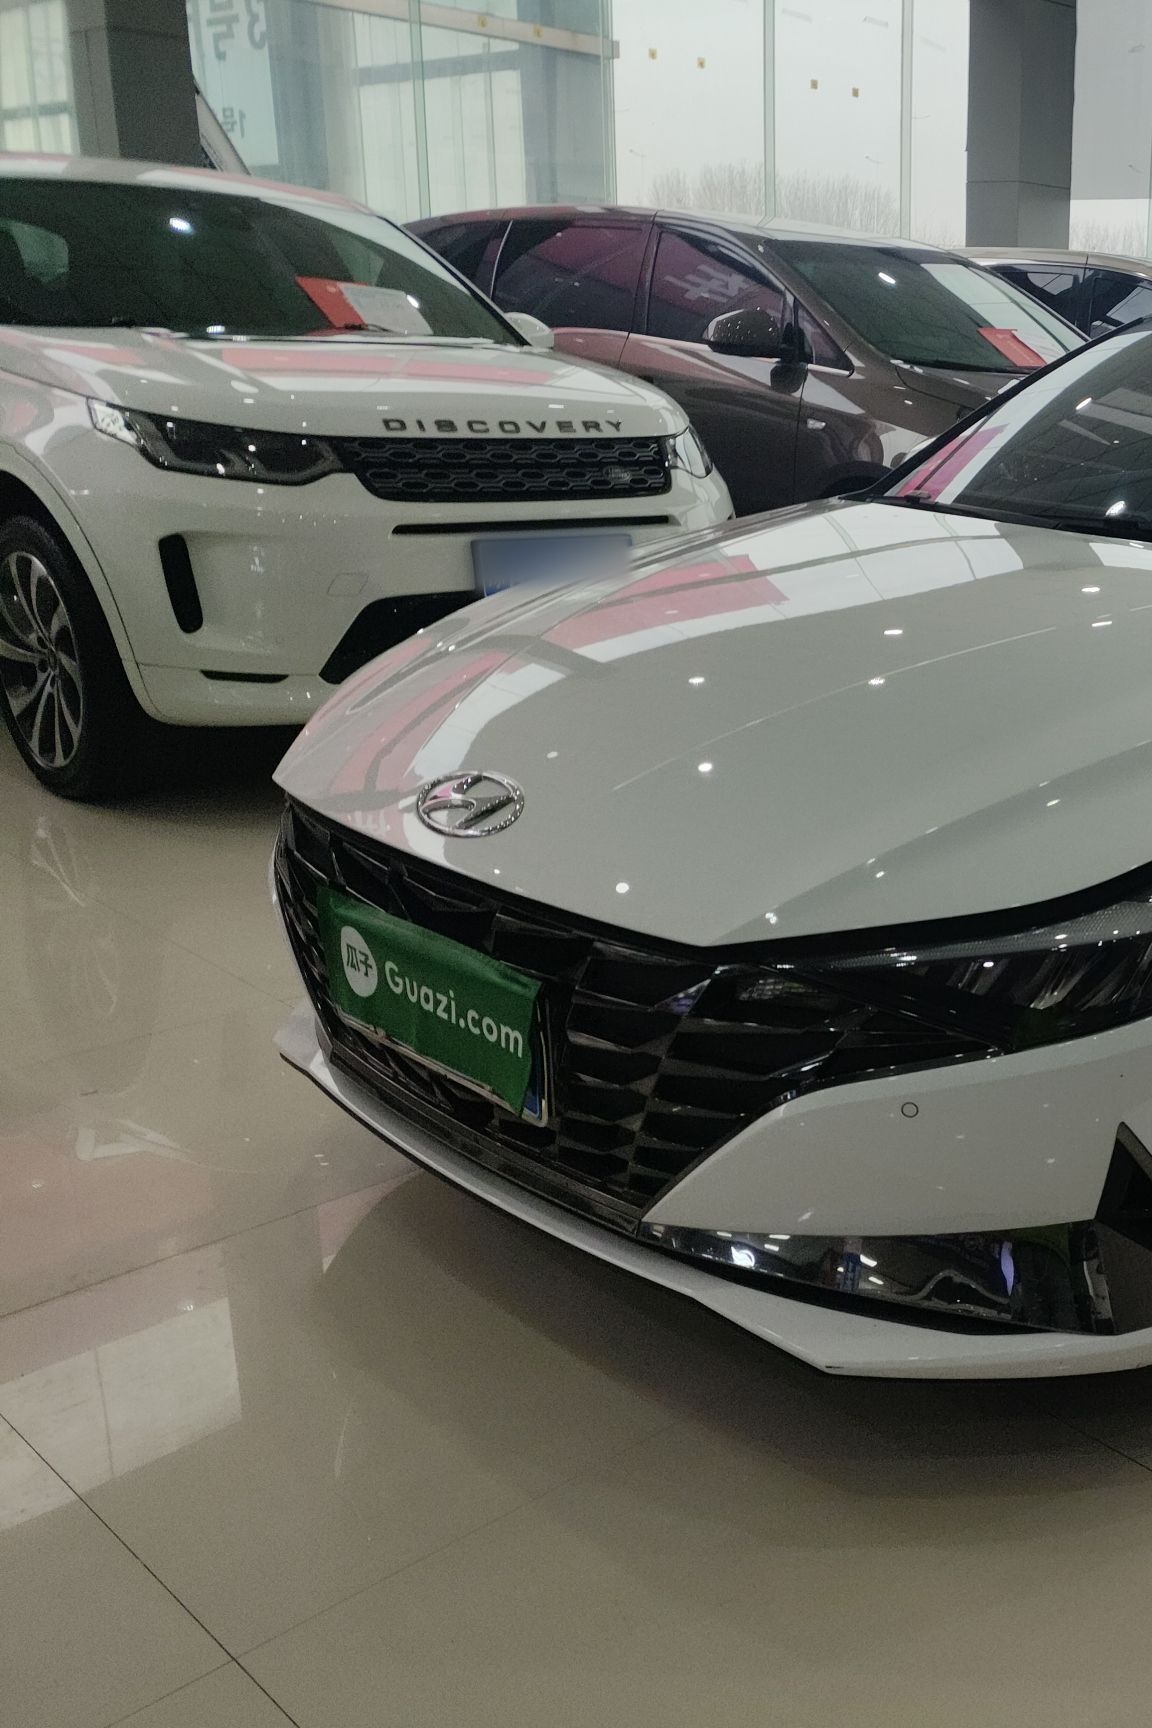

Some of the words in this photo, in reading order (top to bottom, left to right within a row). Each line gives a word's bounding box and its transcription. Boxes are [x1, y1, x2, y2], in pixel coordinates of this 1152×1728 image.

[382, 418, 623, 434] DISCOVERY
[346, 943, 373, 978] 瓜子
[384, 960, 524, 1059] Guazi.com
